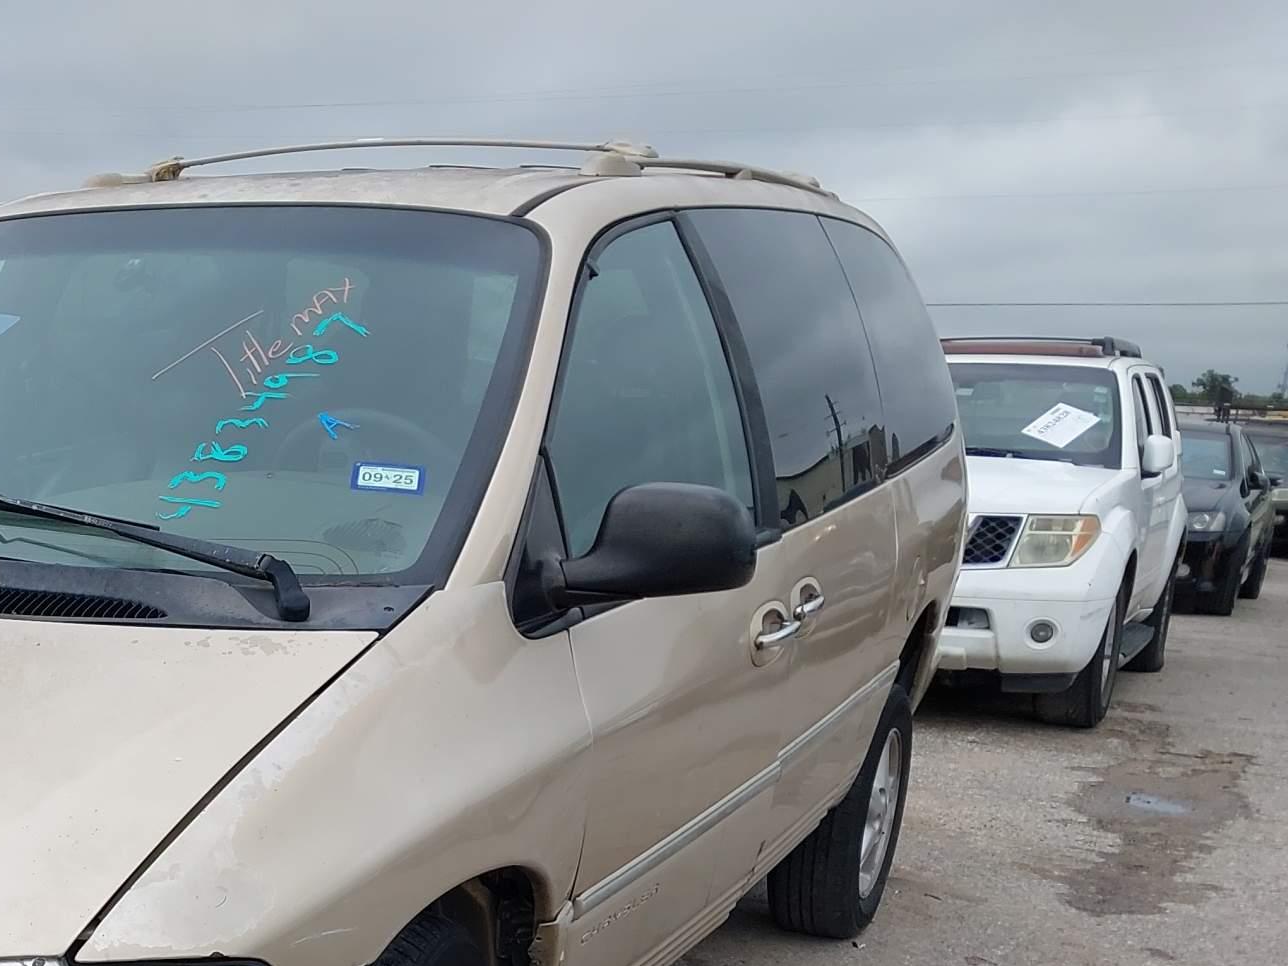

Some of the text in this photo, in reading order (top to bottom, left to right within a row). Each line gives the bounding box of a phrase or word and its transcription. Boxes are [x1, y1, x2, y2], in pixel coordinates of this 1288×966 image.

[155, 312, 370, 520] 43834987
[317, 410, 360, 440] A
[361, 471, 414, 486] 09 25
